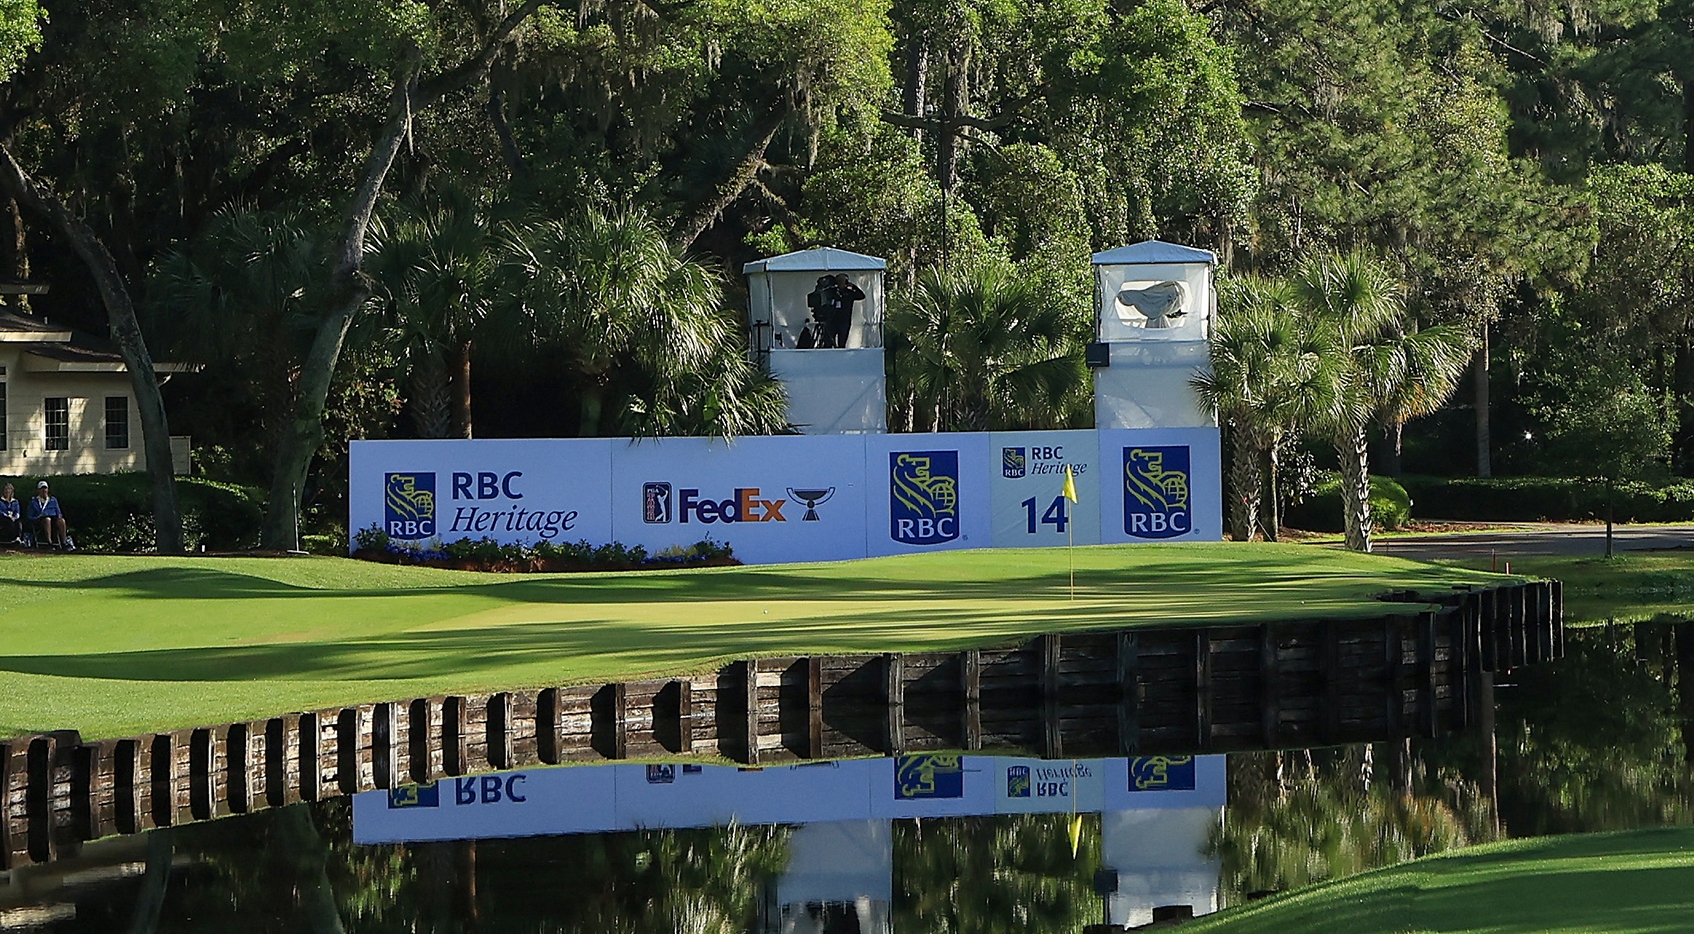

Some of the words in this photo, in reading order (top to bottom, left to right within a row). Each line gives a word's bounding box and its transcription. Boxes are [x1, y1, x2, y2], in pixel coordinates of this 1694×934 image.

[1031, 447, 1064, 460] RBC
[452, 471, 523, 500] RBC
[679, 488, 786, 523] FedEx
[1021, 495, 1069, 533] 14
[390, 519, 432, 536] RBC
[449, 505, 578, 538] Heritage
[897, 517, 955, 539] RBC
[1130, 511, 1188, 533] RBC
